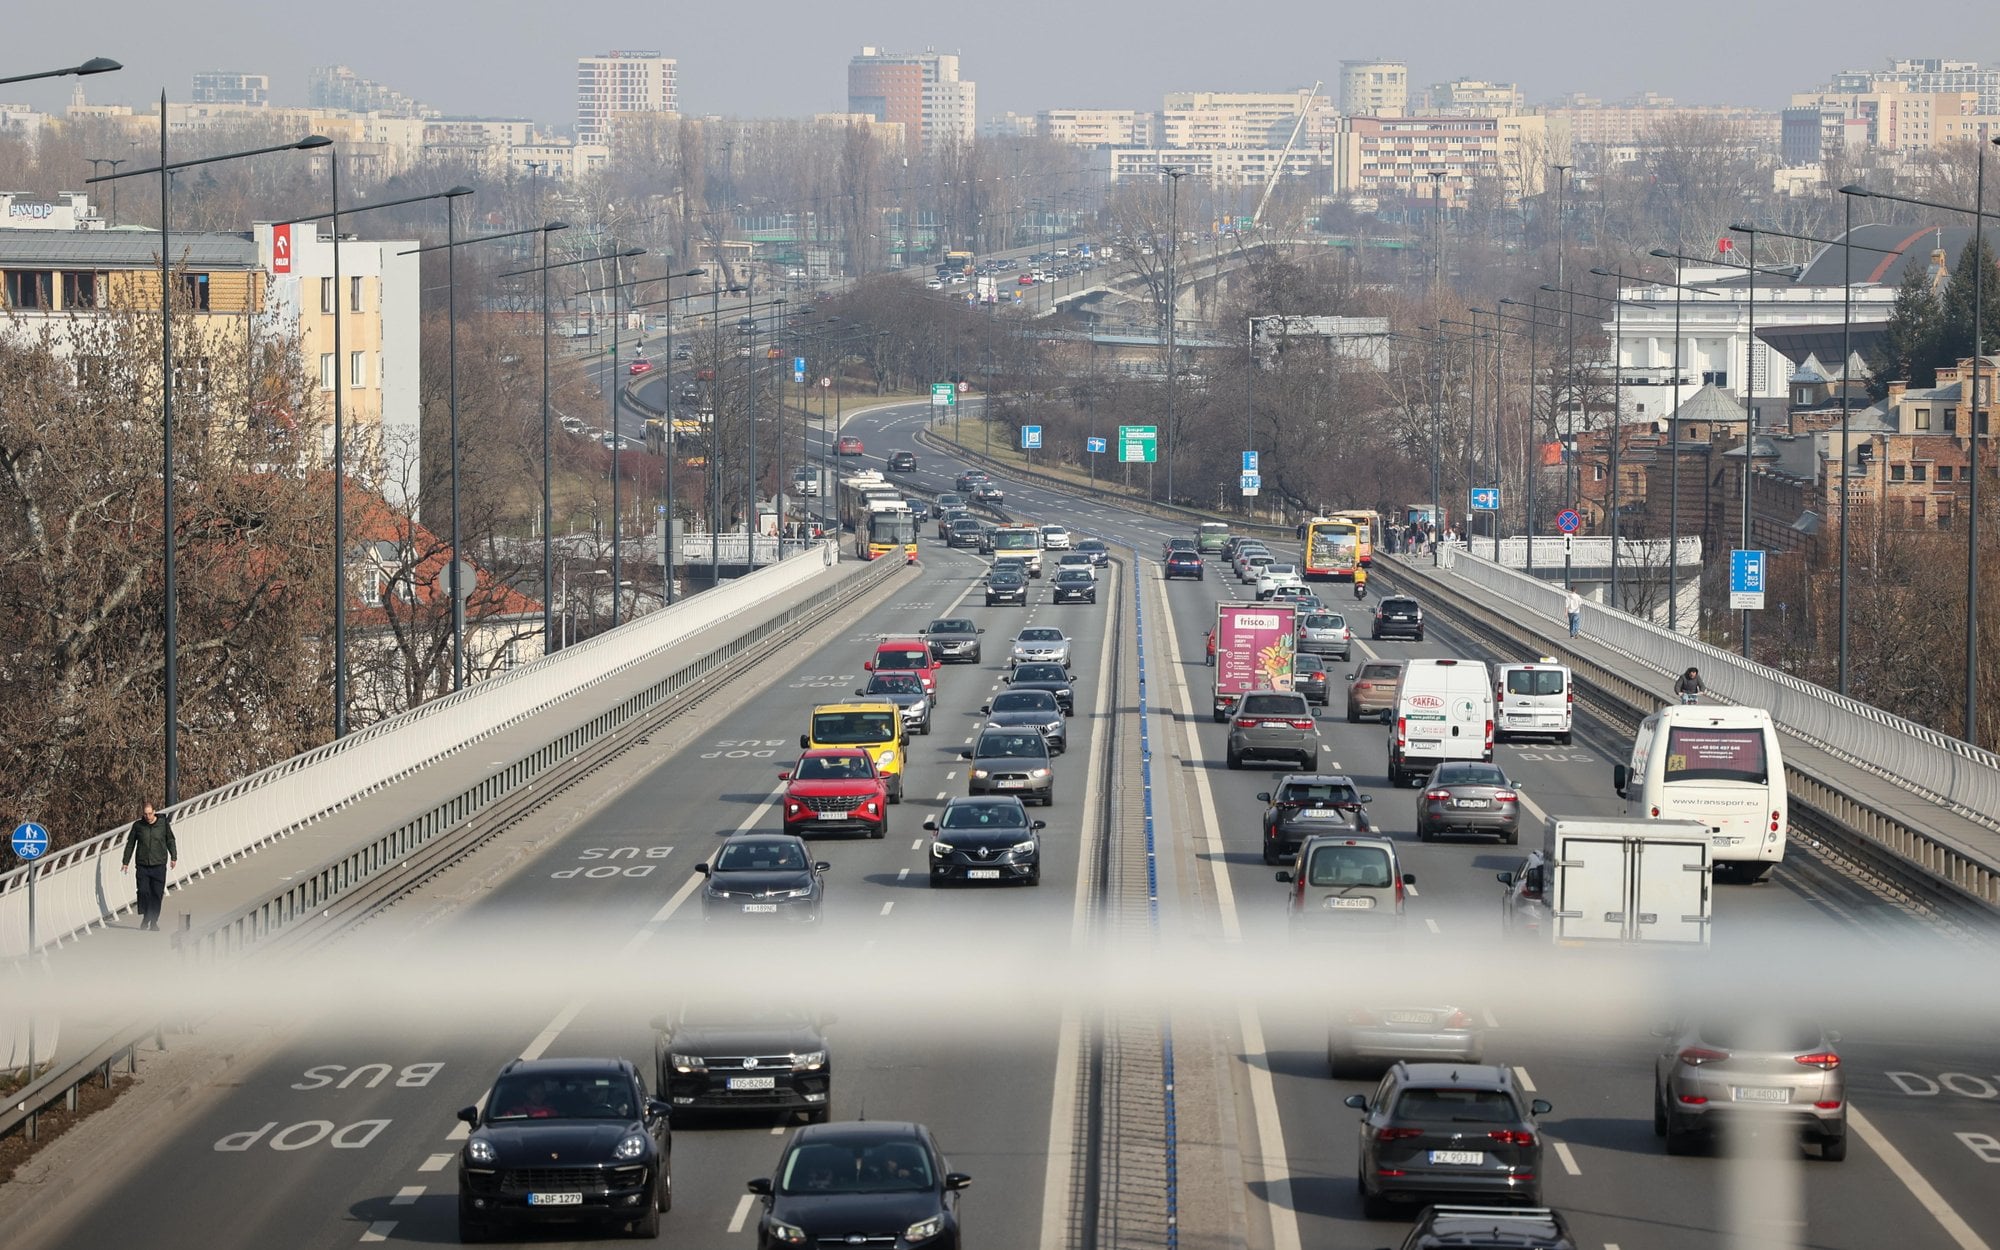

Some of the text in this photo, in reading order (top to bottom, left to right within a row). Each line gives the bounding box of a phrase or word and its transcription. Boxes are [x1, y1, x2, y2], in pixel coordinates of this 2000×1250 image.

[9, 203, 53, 219] HWDP
[1240, 617, 1274, 628] frisco.pl
[1412, 697, 1440, 707] PAKFAL
[715, 739, 786, 748] BUS
[700, 750, 777, 759] DOP
[1518, 753, 1595, 763] BUS
[1672, 799, 1759, 808] www.transsport.eu
[578, 846, 675, 860] BUS
[550, 865, 657, 879] DOP
[291, 1062, 446, 1090] BUS
[733, 1079, 774, 1088] TOS 82866
[1885, 1071, 2000, 1099] DO
[213, 1118, 393, 1152] DOP
[1436, 1152, 1448, 1162] WZ
[545, 1195, 556, 1203] BF
[559, 1194, 581, 1203] 1279
